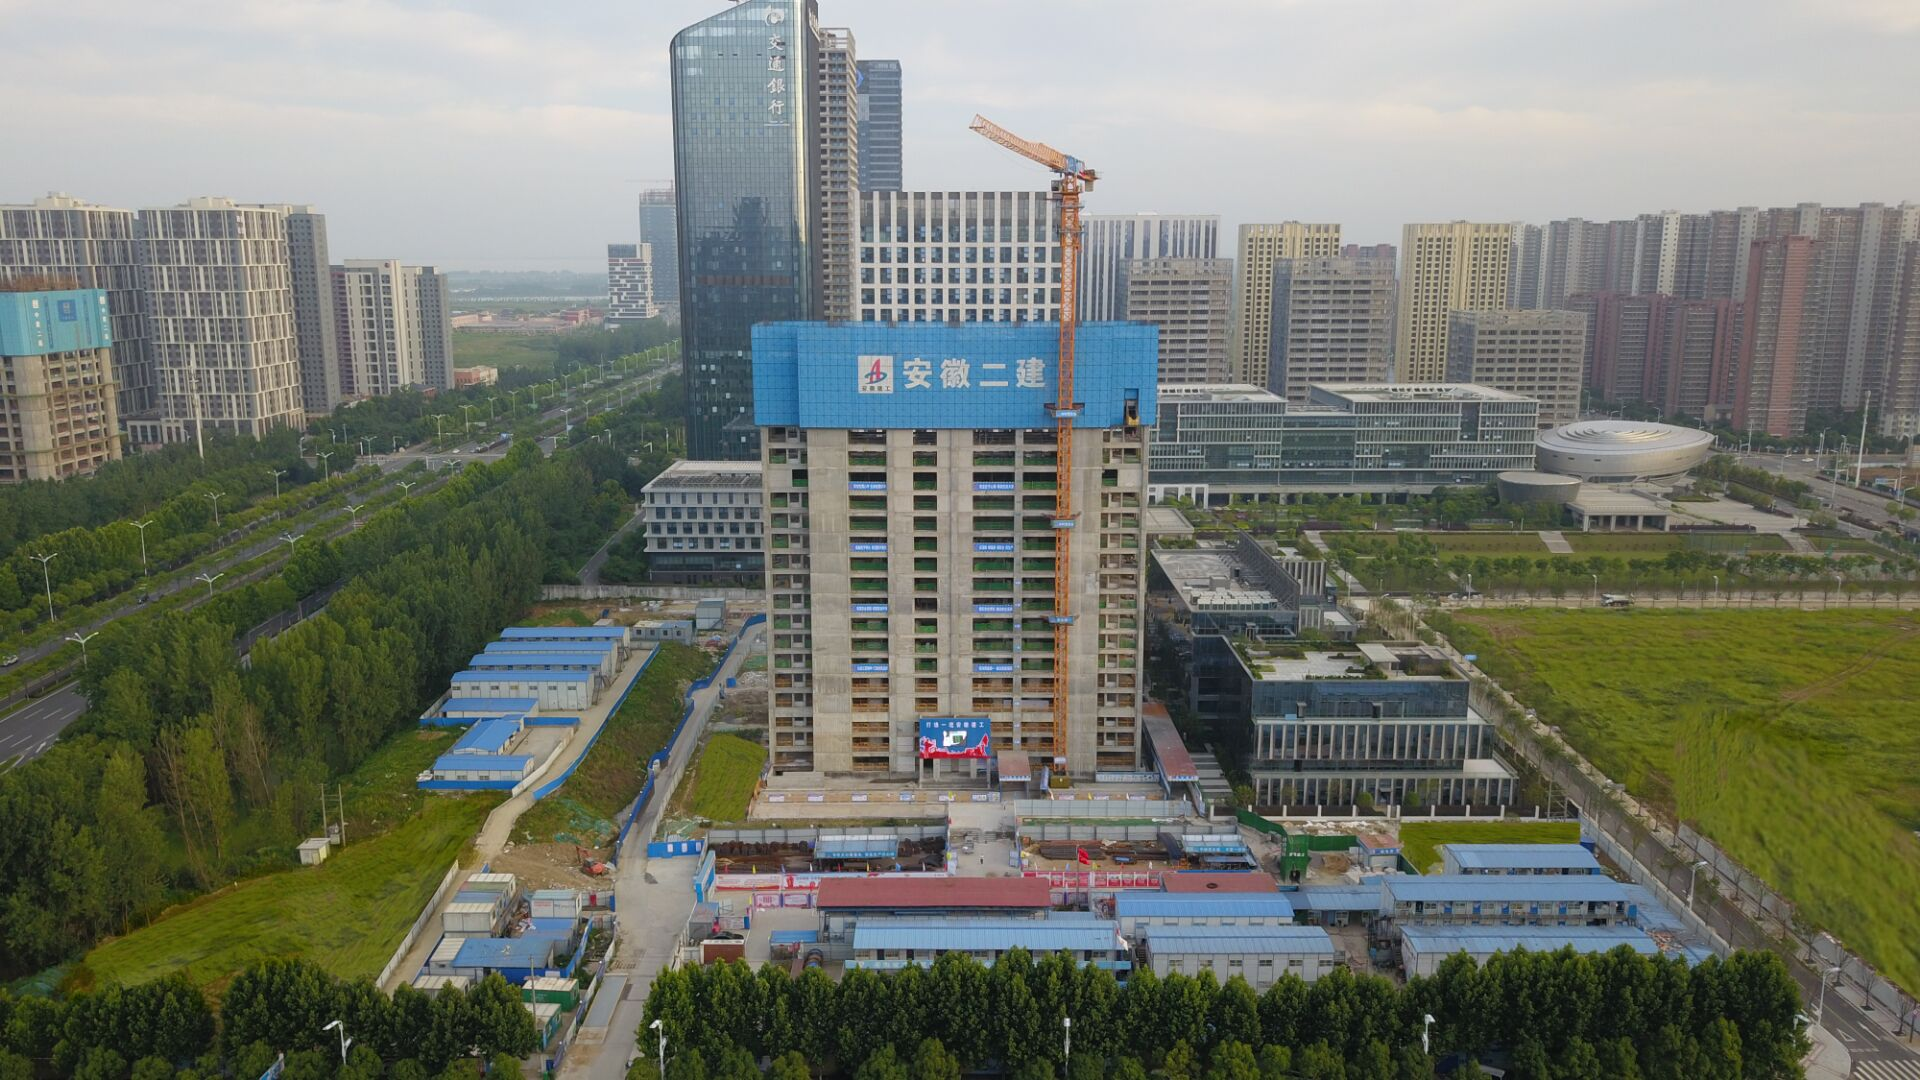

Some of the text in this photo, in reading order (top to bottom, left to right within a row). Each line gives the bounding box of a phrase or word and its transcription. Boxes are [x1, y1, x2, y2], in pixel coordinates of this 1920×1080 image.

[767, 33, 786, 115] 交通銀行
[902, 357, 1046, 389] 安徽二建
